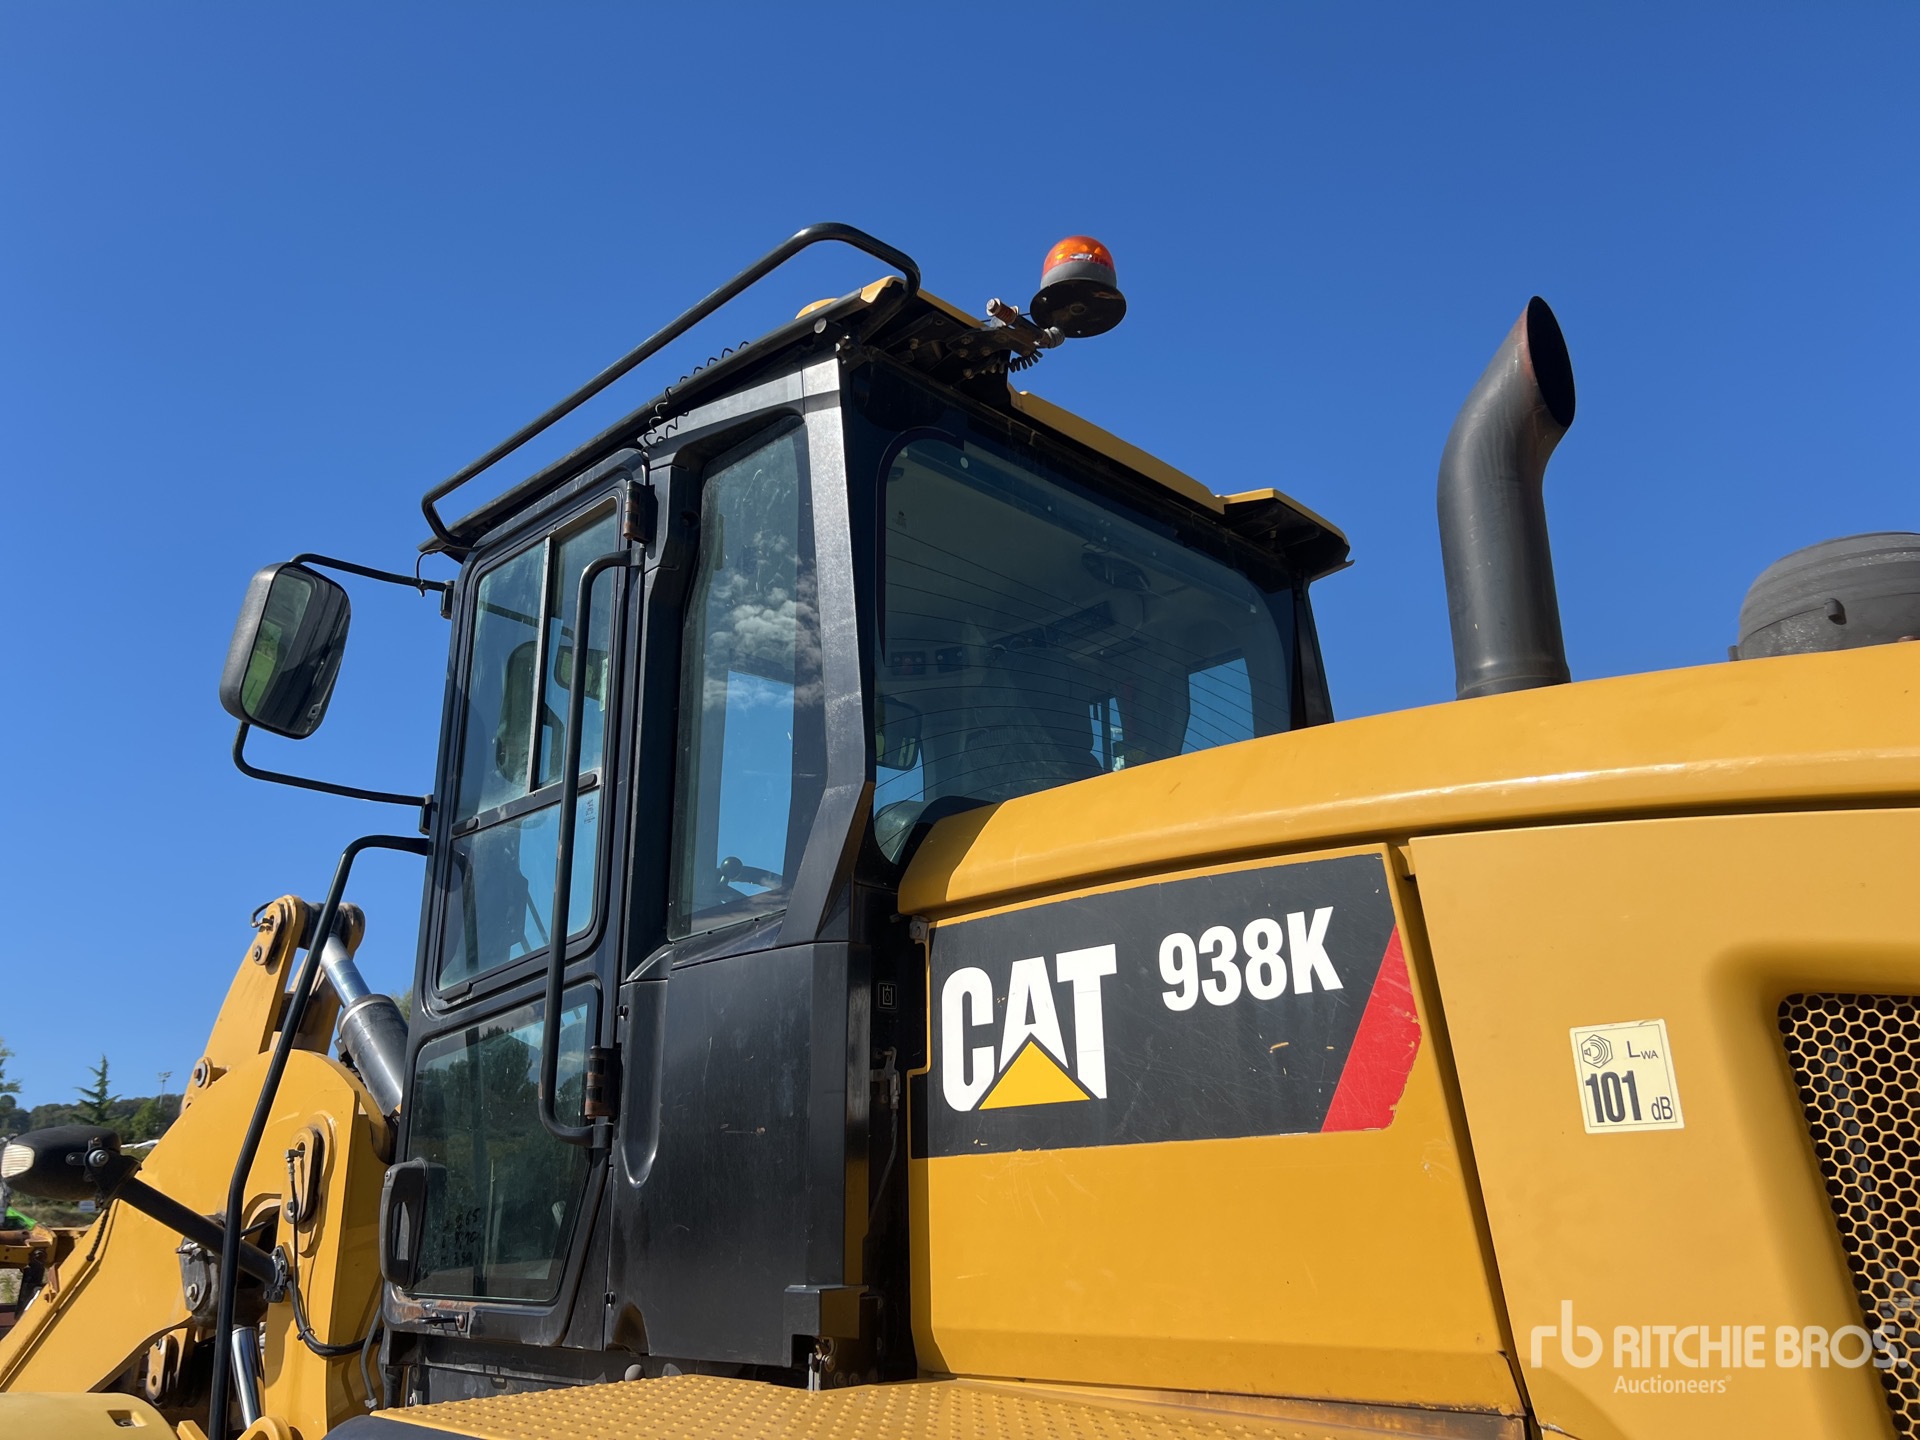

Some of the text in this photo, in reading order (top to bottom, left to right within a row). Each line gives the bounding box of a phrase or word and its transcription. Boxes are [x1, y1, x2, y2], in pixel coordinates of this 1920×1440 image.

[941, 906, 1344, 1112] CAT 938K
[1585, 1070, 1673, 1123] 101 dB
